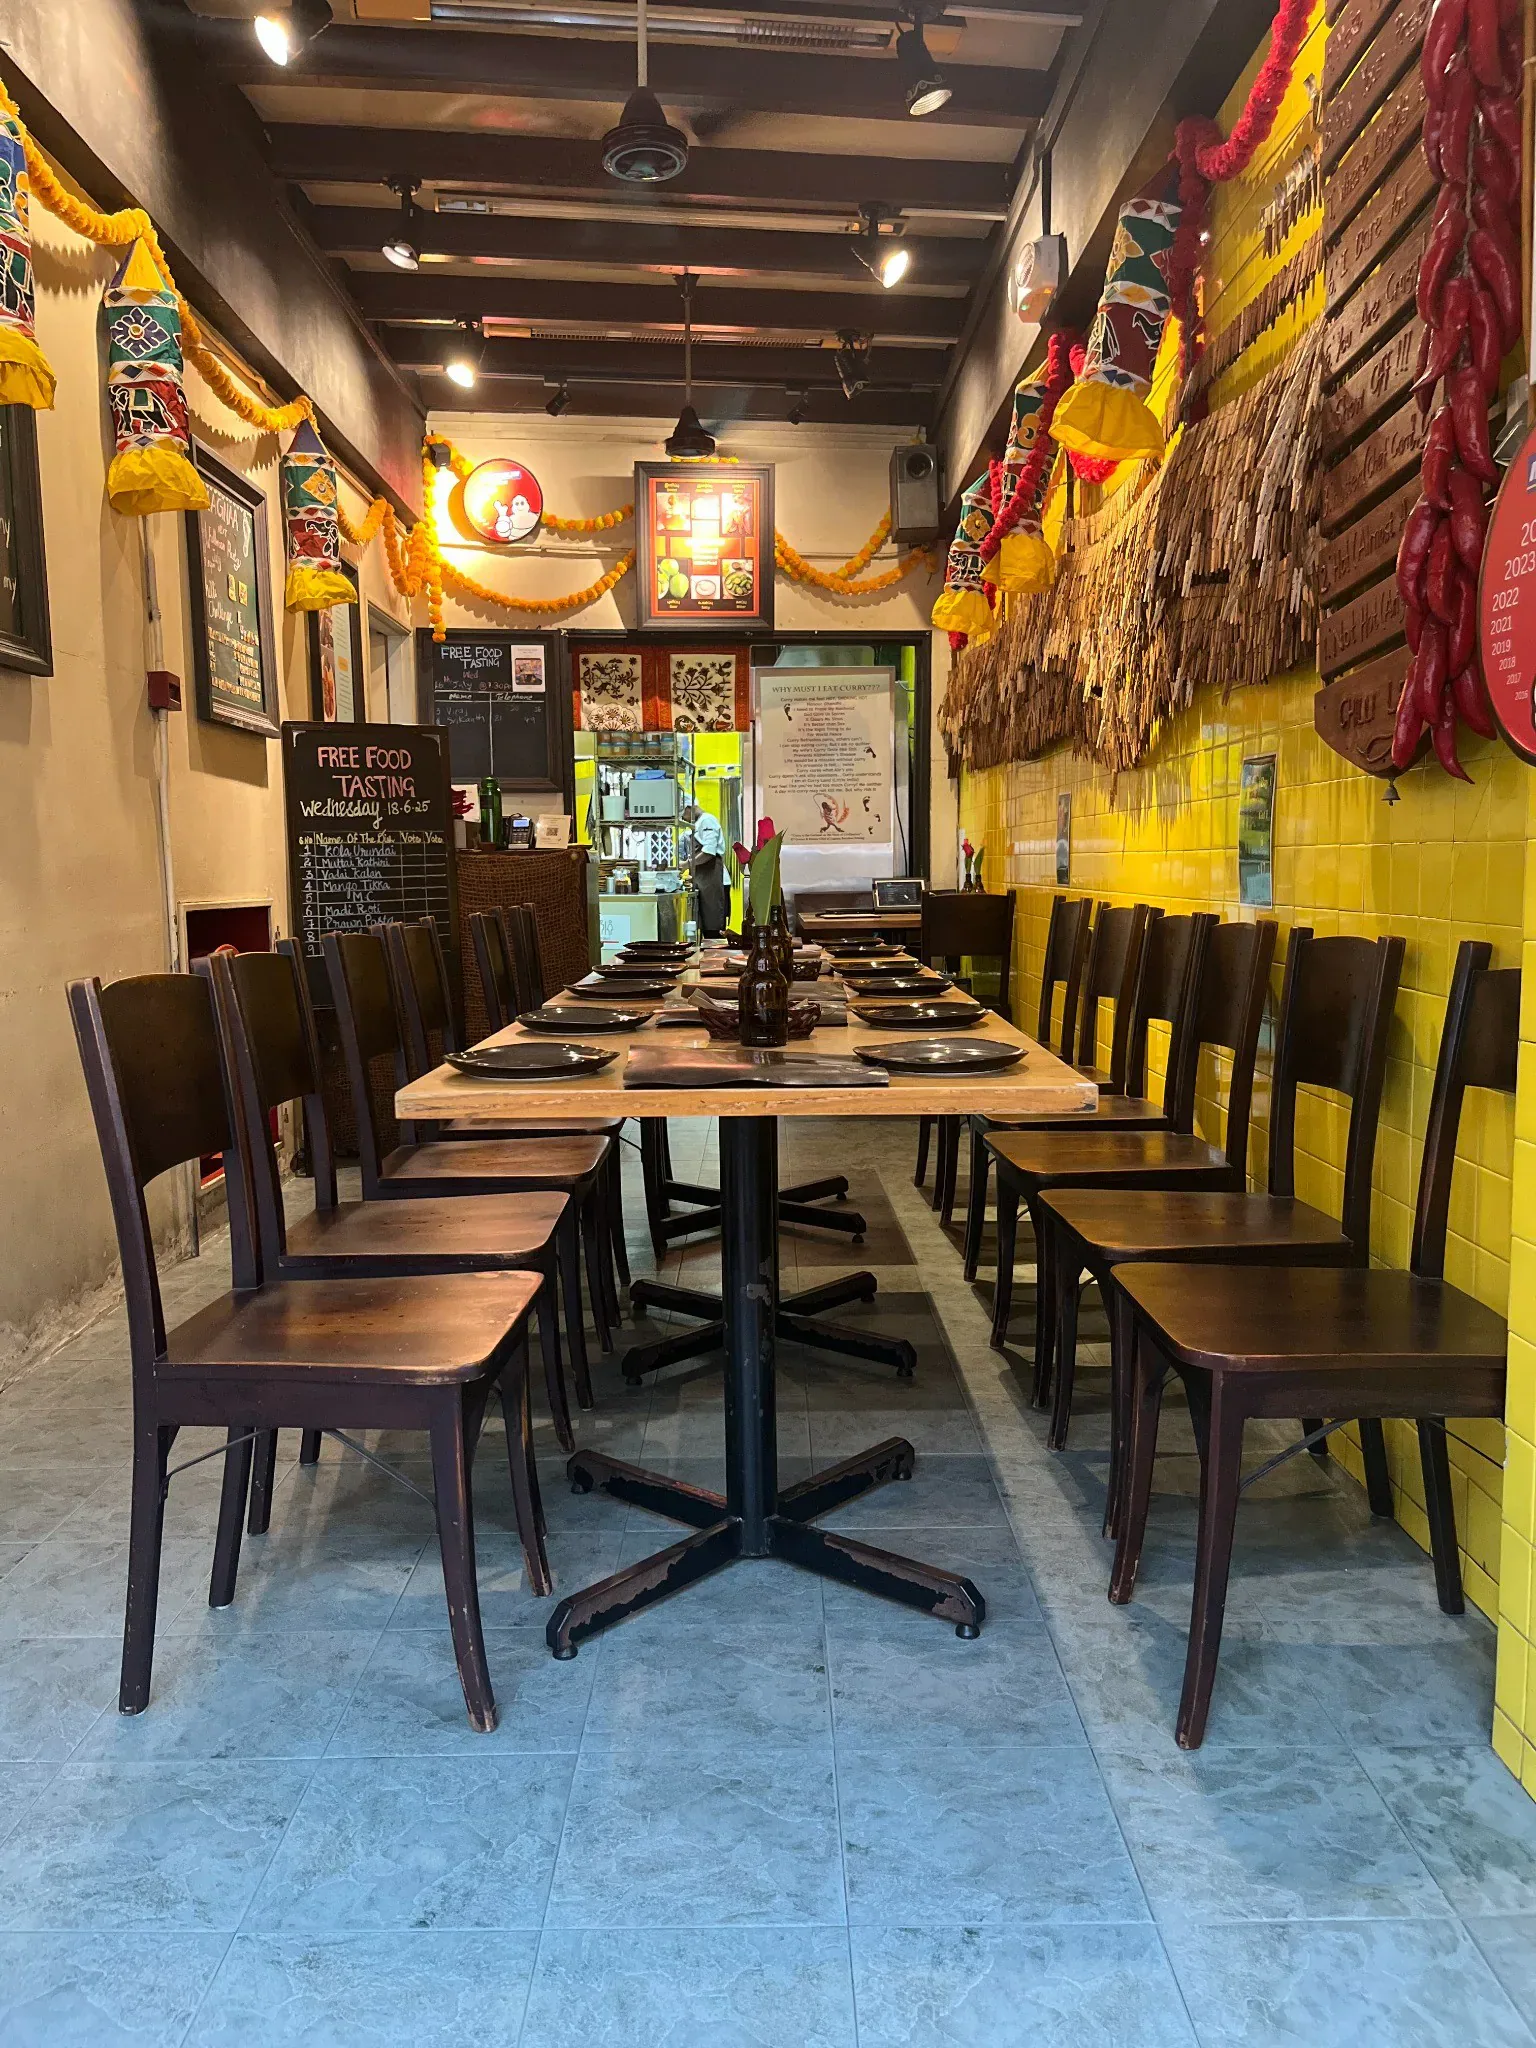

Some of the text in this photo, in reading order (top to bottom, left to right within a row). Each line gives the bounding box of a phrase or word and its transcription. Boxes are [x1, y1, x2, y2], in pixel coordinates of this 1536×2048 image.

[1503, 553, 1536, 582] 2023
[1491, 586, 1520, 613] 2022
[1490, 618, 1513, 636] 2021
[440, 646, 471, 660] FREE
[475, 646, 503, 658] FOOD
[1491, 639, 1512, 657] 2019
[460, 657, 500, 669] TASTING
[1498, 655, 1516, 672] 2018
[1506, 672, 1522, 686] 2017
[793, 685, 817, 693] MUST
[496, 692, 533, 701] Telephone
[317, 745, 412, 770] FREE FOOD
[332, 774, 416, 799] TASTING
[299, 798, 383, 830] Wednesday
[315, 832, 344, 844] Name
[346, 832, 359, 844] Of
[359, 832, 375, 844] The
[401, 832, 422, 844] Vote
[425, 831, 444, 844] Vote
[303, 845, 312, 856] 1
[303, 857, 312, 867] 2
[321, 857, 355, 869] Muttai
[305, 869, 314, 879] 3
[304, 881, 313, 891] 4
[322, 881, 358, 899] Mango
[305, 892, 313, 903] 5
[305, 903, 382, 916] 6 Madi Roti
[307, 918, 315, 929] 7
[324, 916, 363, 929] Prawn
[307, 932, 316, 943] 8
[307, 944, 316, 956] 9
